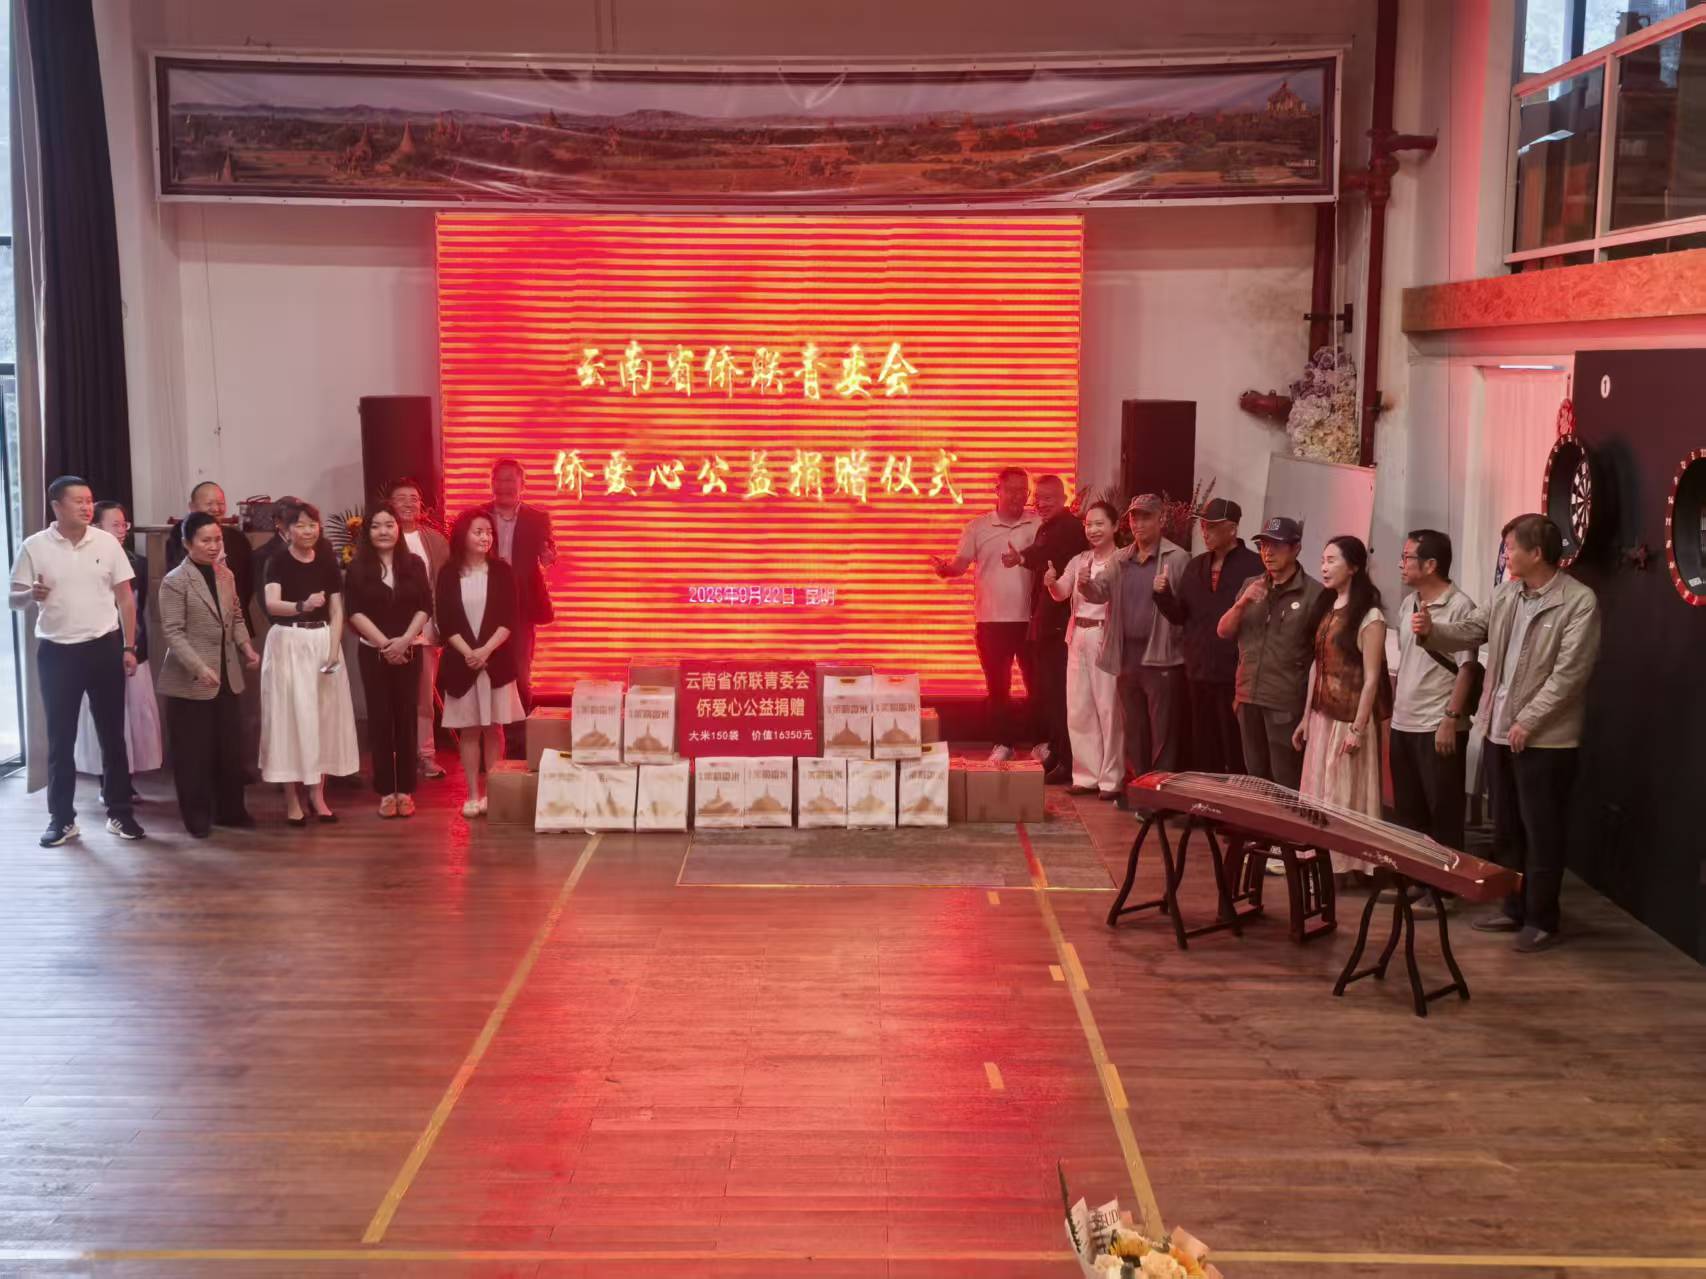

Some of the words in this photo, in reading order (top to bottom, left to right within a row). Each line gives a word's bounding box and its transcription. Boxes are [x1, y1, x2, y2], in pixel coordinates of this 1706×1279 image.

[576, 341, 918, 399] 云南省侨联青委会
[554, 448, 964, 504] 侨爱心公益捐赠仪式
[686, 670, 810, 690] 云南省侨联青委会
[696, 697, 805, 717] 侨爱心公益捐赠
[688, 730, 740, 741] 大米150袋
[751, 730, 813, 741] 价值16350元
